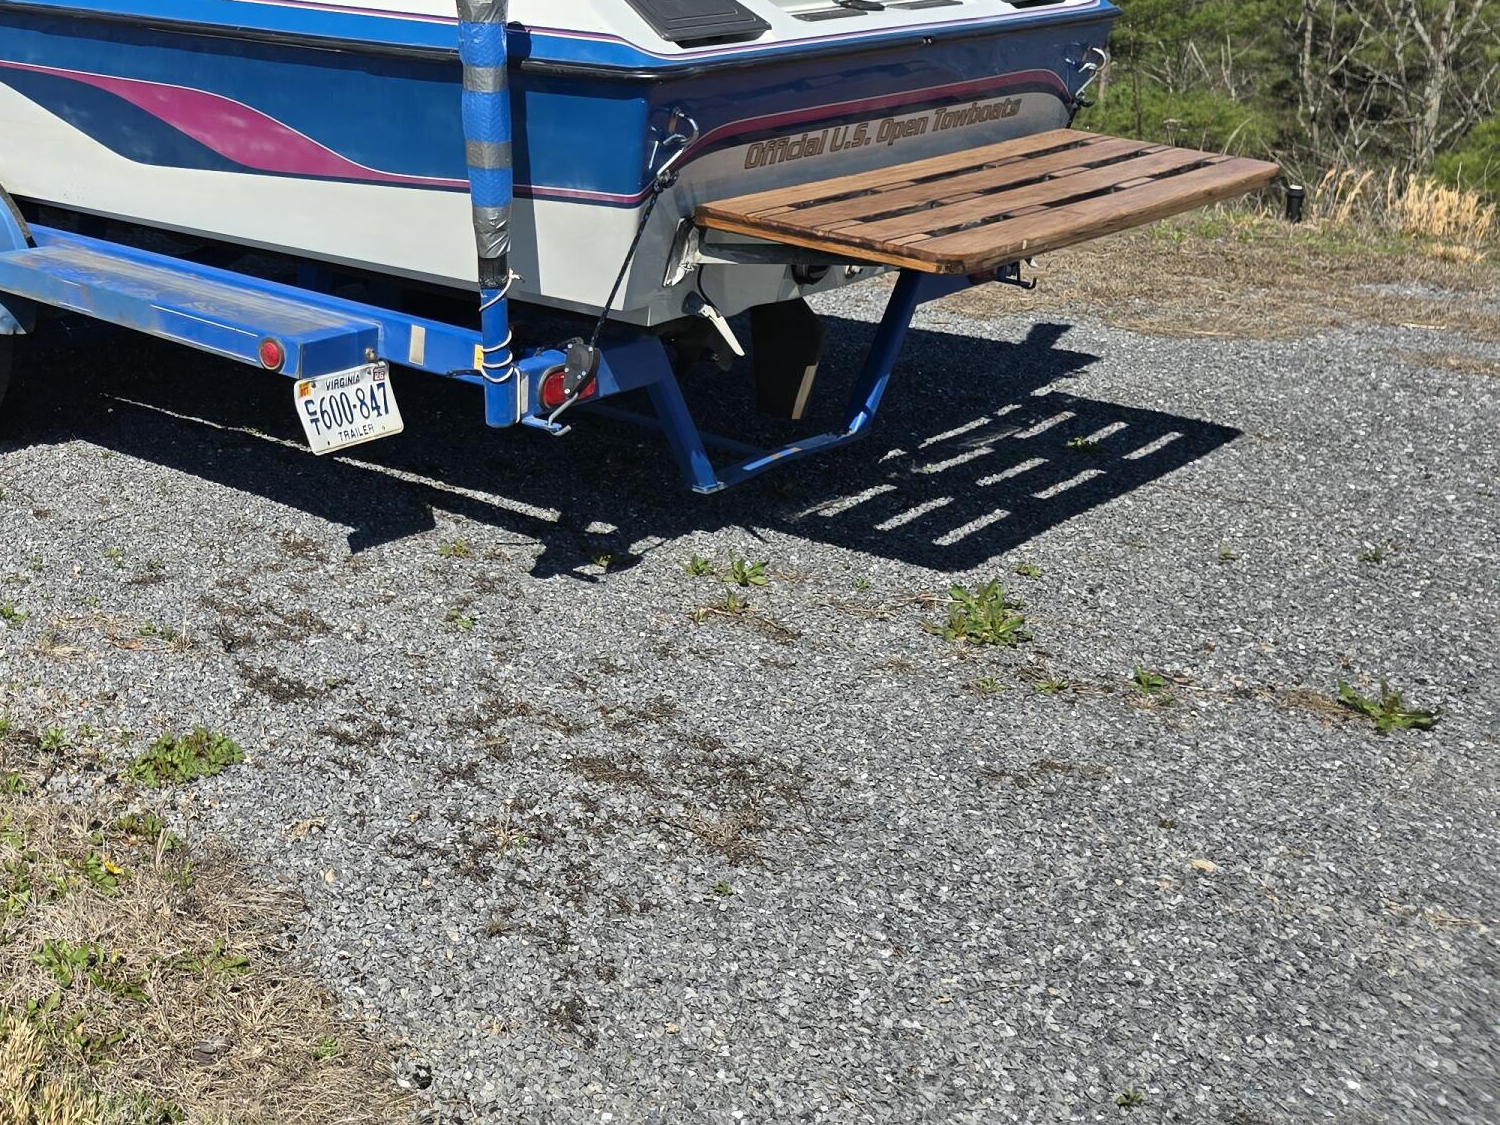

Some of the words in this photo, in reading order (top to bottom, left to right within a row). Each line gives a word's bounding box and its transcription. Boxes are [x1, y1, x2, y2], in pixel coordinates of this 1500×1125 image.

[744, 130, 828, 169] Official
[830, 121, 871, 152] U.S.
[876, 117, 929, 146] Open
[932, 98, 1022, 132] Towboats
[325, 372, 361, 391] VIRGINIA
[338, 423, 375, 442] TRAILER
